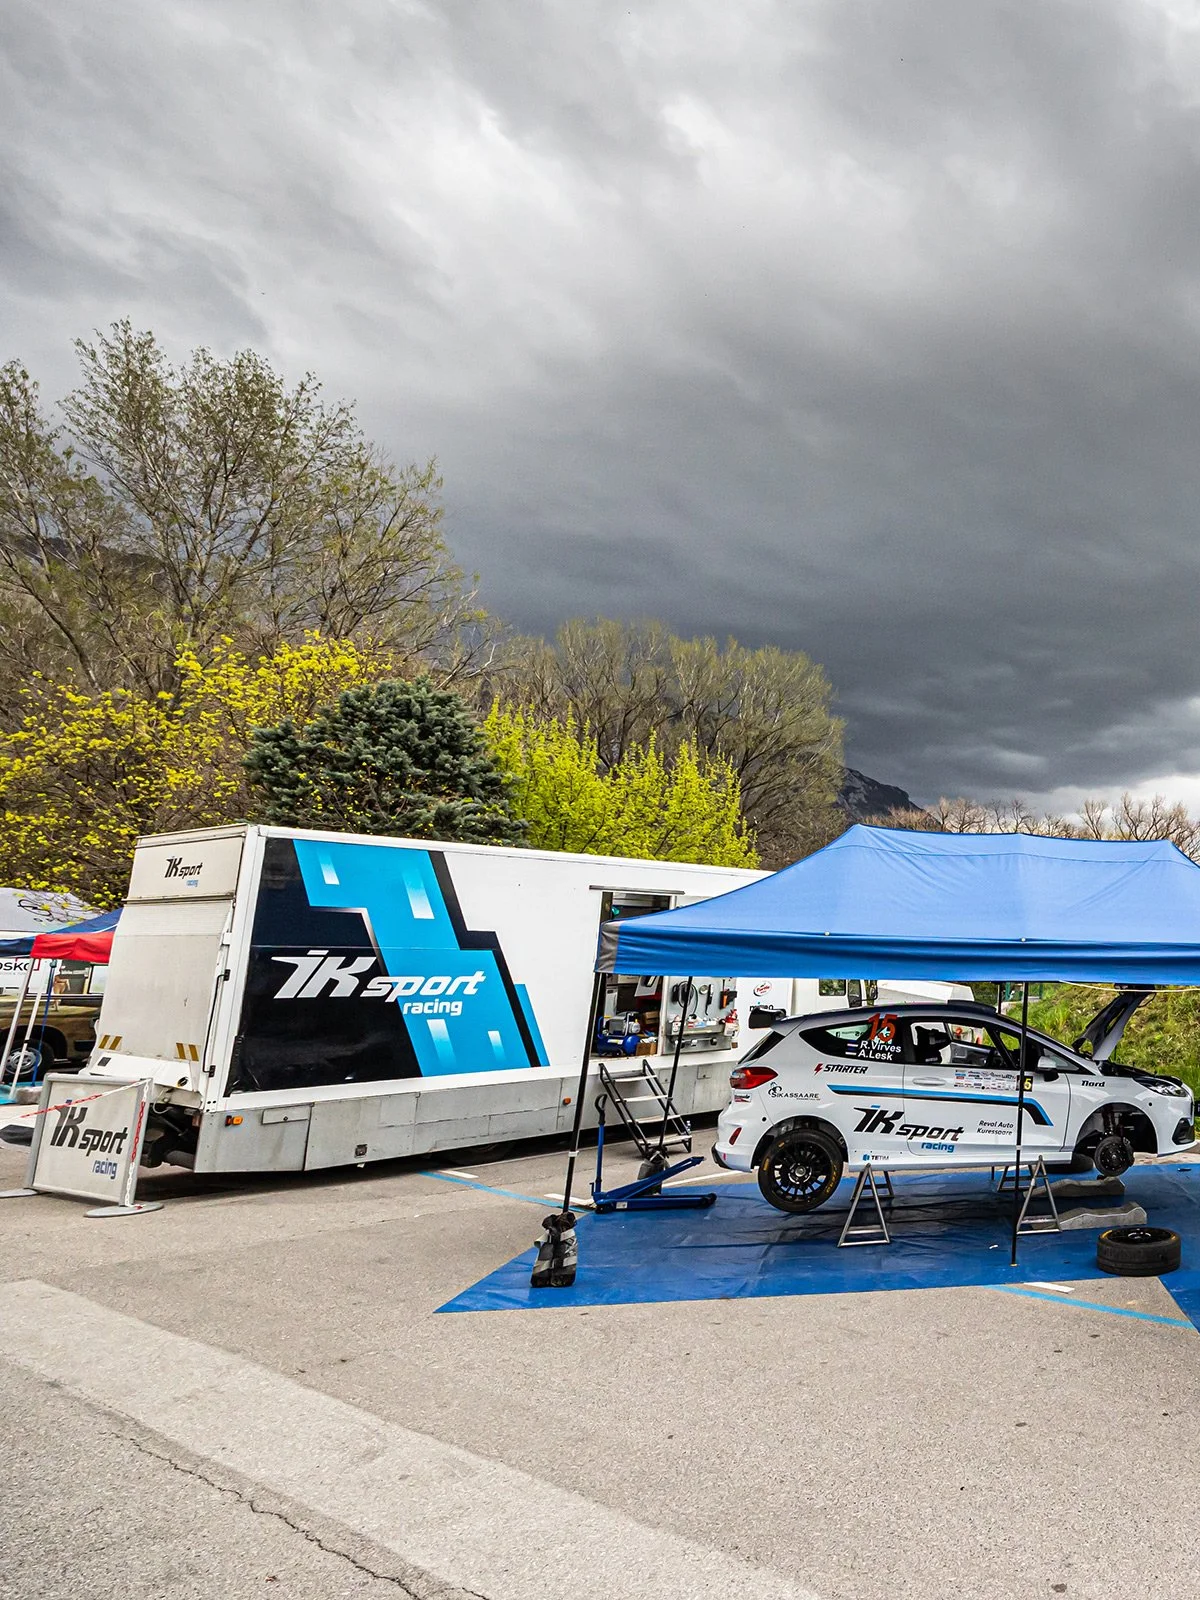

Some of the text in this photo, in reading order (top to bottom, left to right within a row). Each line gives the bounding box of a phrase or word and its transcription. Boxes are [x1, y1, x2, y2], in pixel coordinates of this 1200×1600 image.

[403, 999, 462, 1016] racing
[868, 1012, 898, 1042] 15
[823, 1064, 868, 1074] STARTER
[977, 1128, 1013, 1136] Kuressaare
[921, 1142, 955, 1153] racing
[92, 1158, 118, 1180] racing
